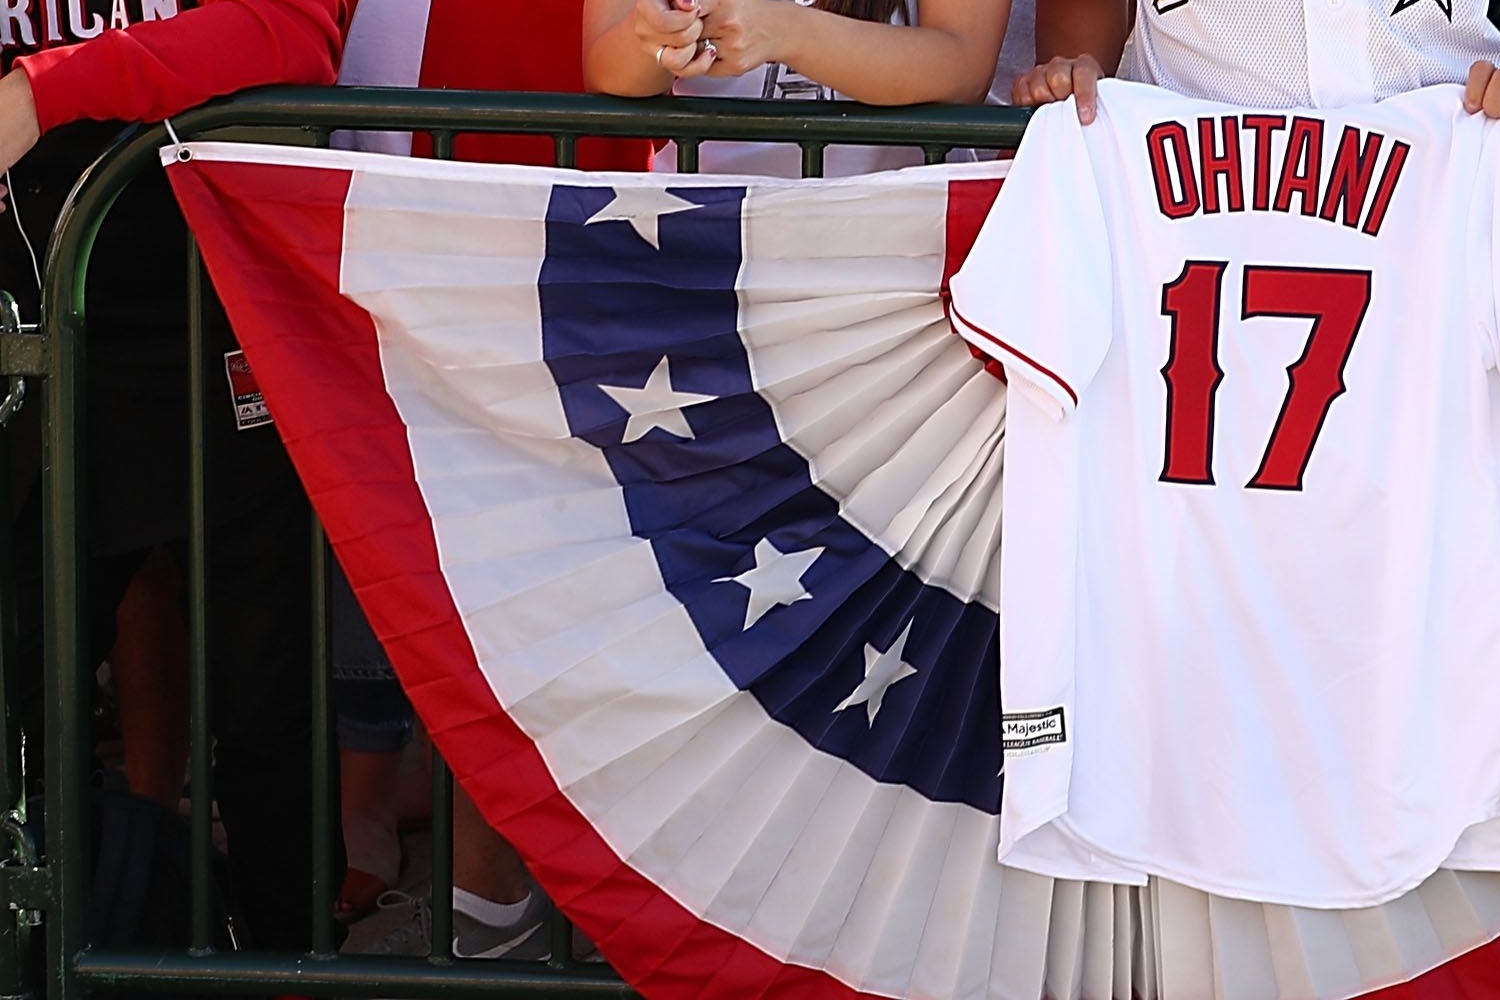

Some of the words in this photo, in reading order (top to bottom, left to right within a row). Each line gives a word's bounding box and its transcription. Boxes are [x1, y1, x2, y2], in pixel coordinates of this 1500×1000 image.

[1146, 115, 1411, 237] OHTANI
[1160, 260, 1373, 492] 17
[1007, 718, 1057, 738] Majestic
